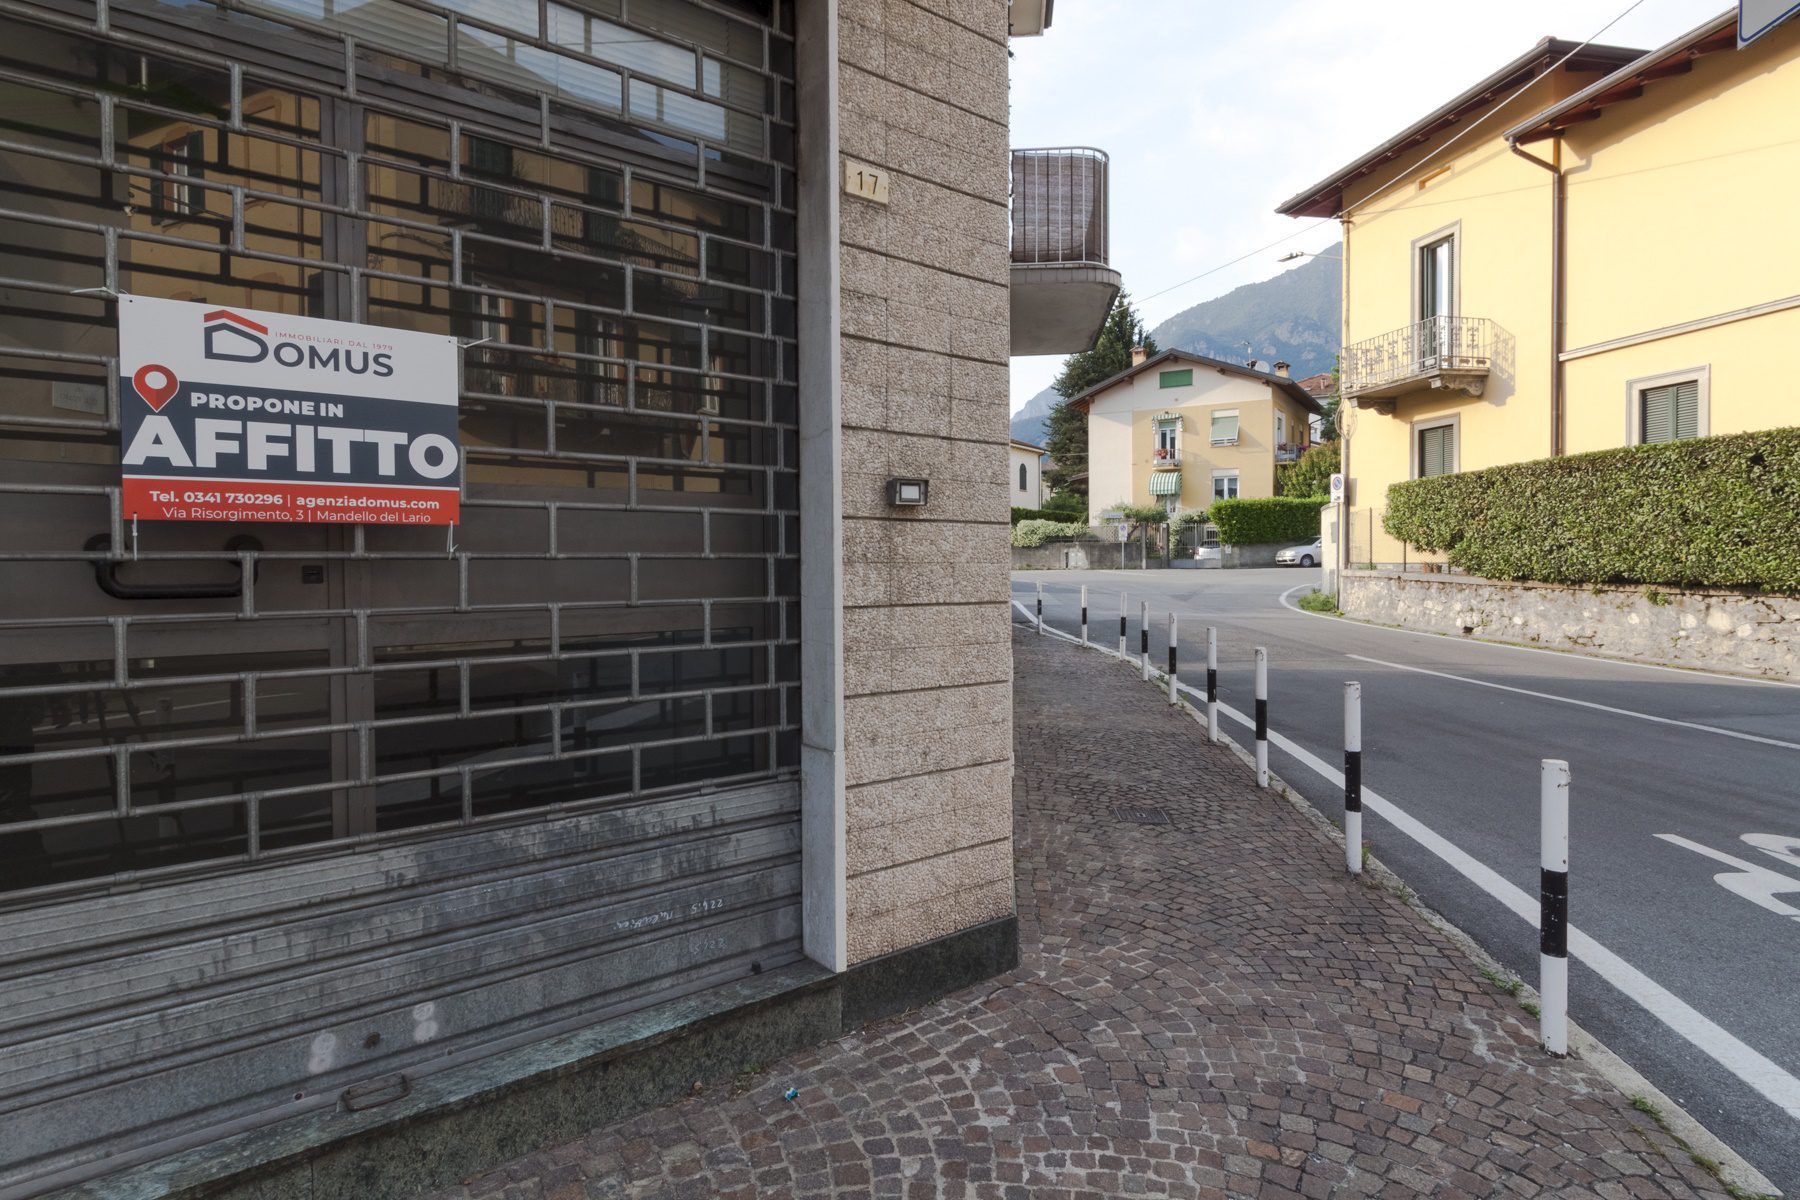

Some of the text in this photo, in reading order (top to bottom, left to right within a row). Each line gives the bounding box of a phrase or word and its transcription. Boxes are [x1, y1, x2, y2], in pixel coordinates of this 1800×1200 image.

[857, 170, 879, 195] 17
[204, 322, 394, 377] DOMUS
[275, 331, 394, 351] IMMOBILIARI DAL 1979
[190, 391, 344, 418] PROPONE IN
[122, 414, 459, 479] AFFITTO
[149, 490, 440, 509] Tel. 0341 730296 agenziadomus.com
[162, 506, 431, 523] Via Risorgimento, 3 Mandello del Lario
